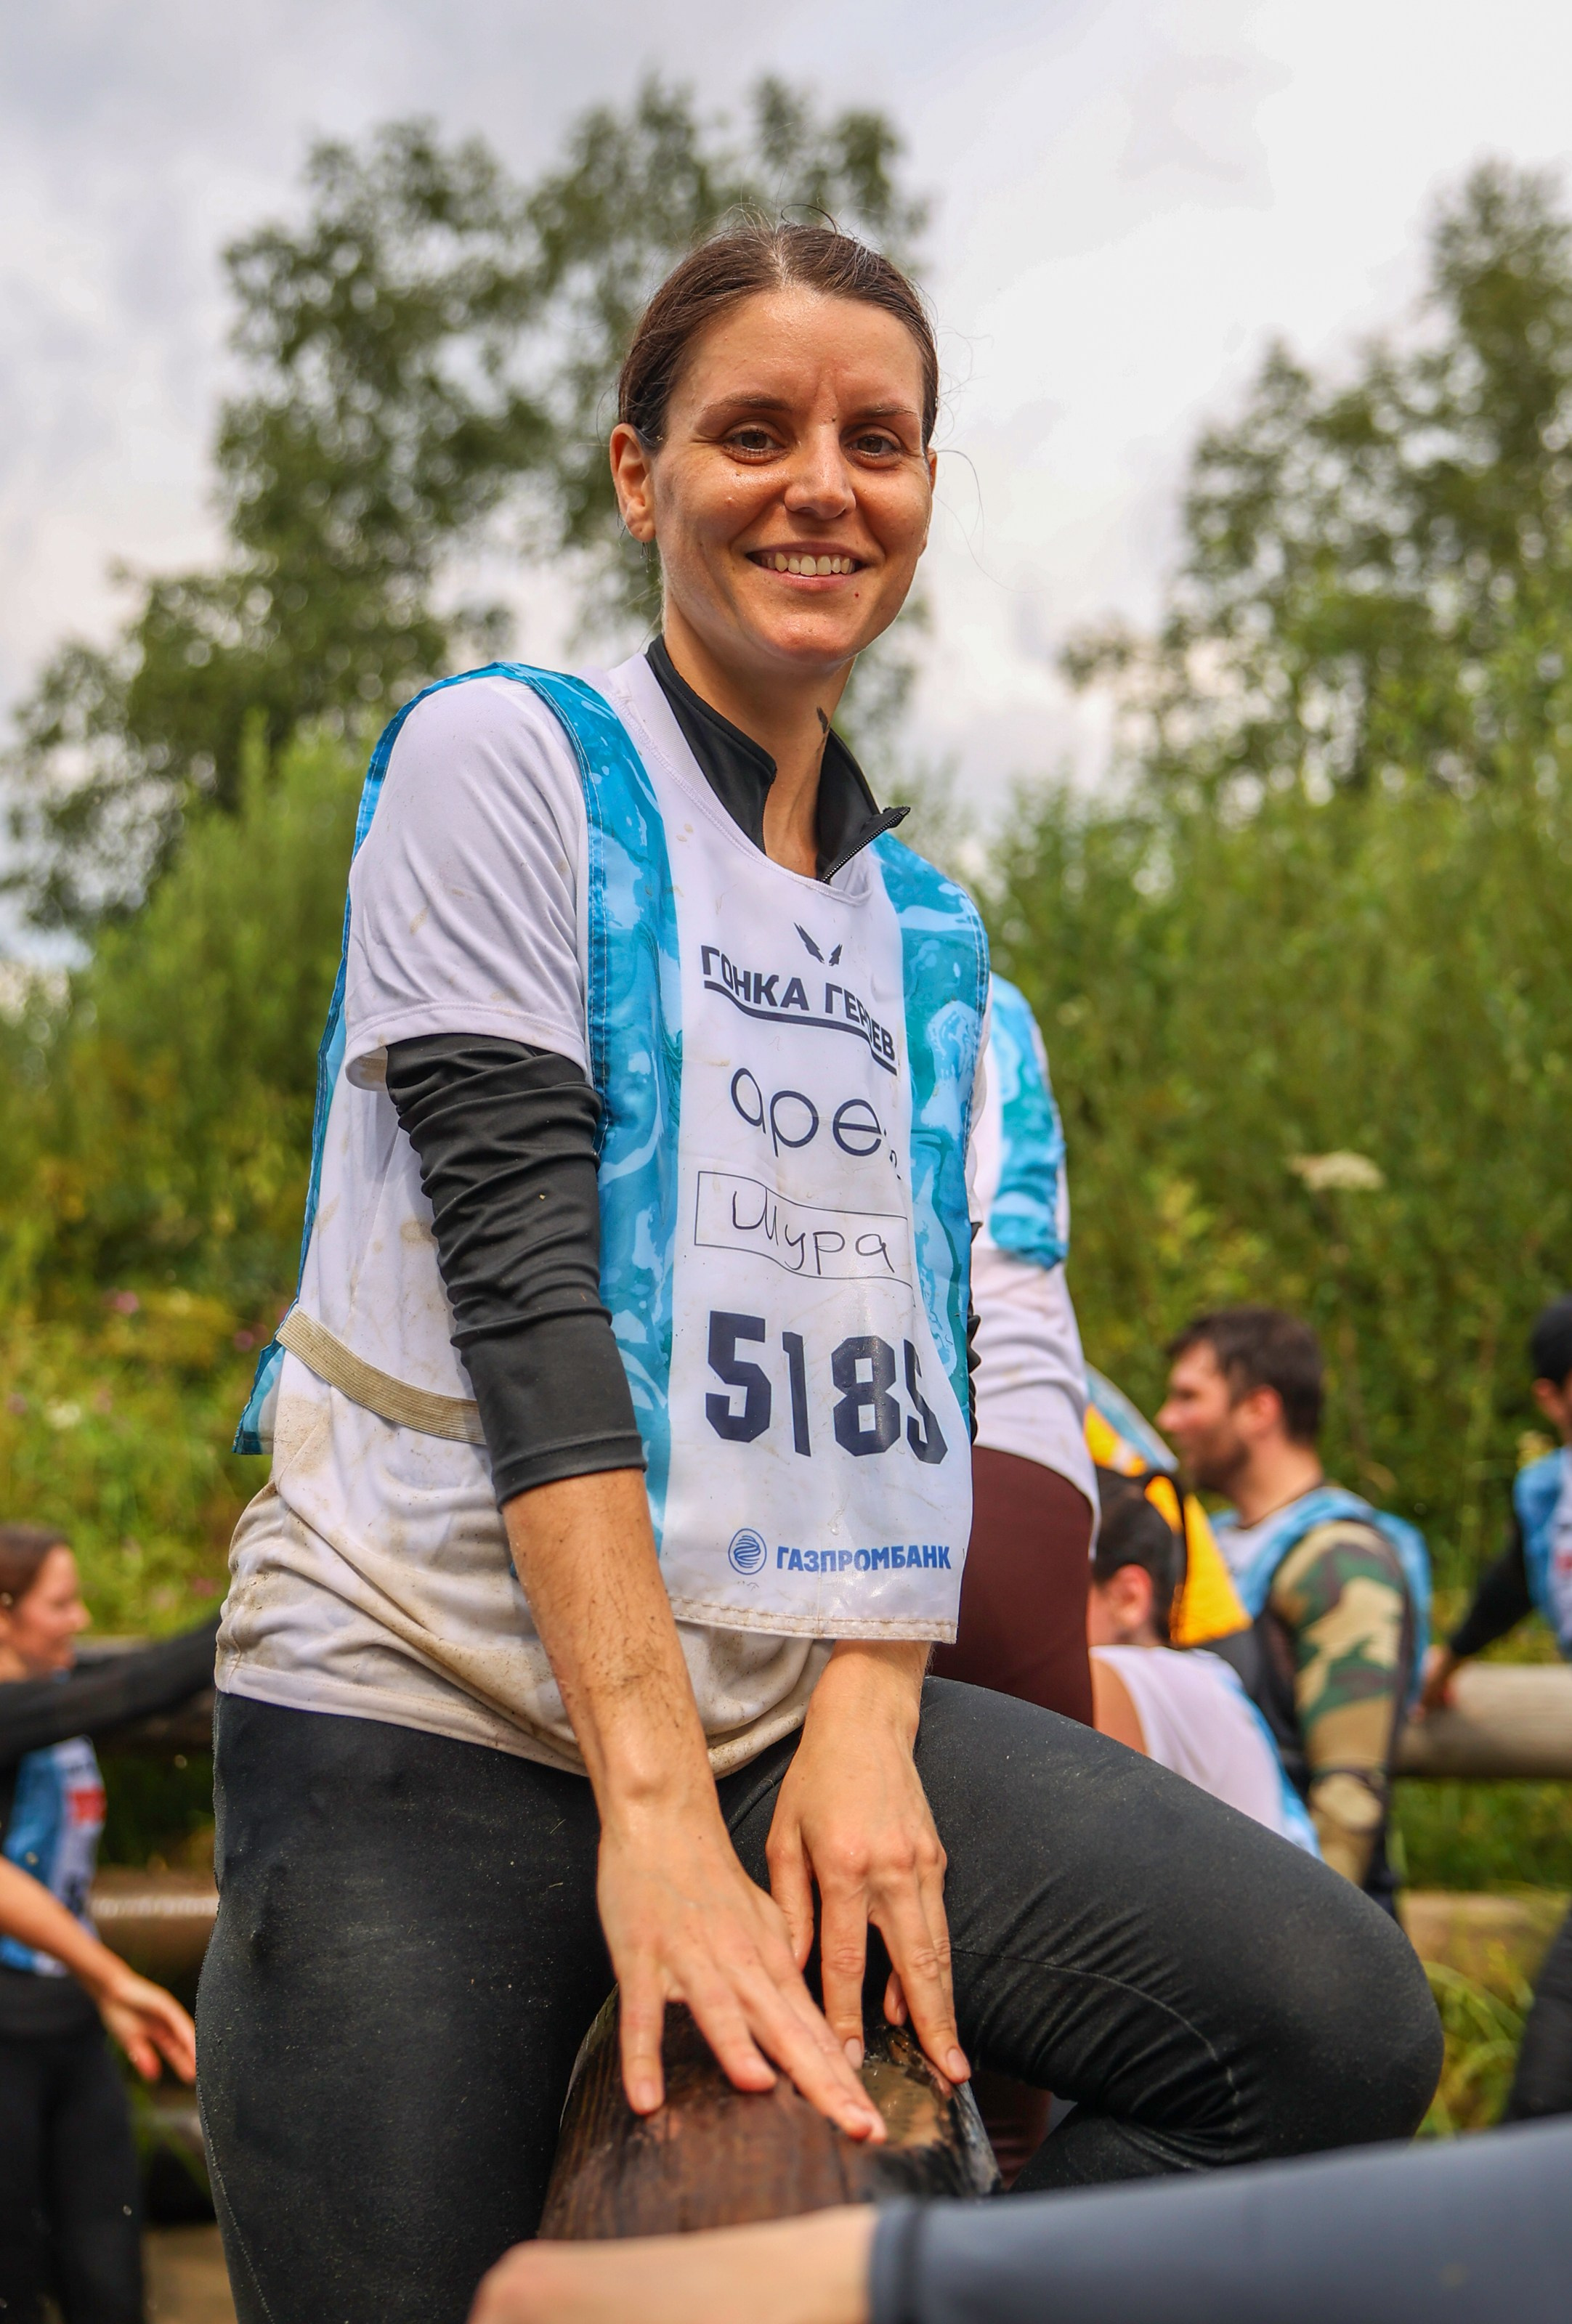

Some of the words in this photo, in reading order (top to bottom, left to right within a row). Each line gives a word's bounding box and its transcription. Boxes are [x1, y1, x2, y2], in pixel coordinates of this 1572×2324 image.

[701, 945, 810, 1011] ГОНКА
[732, 1190, 896, 1275] Шура
[706, 1310, 948, 1465] 5185
[777, 1545, 952, 1572] ГАЗПРОМБАНК
